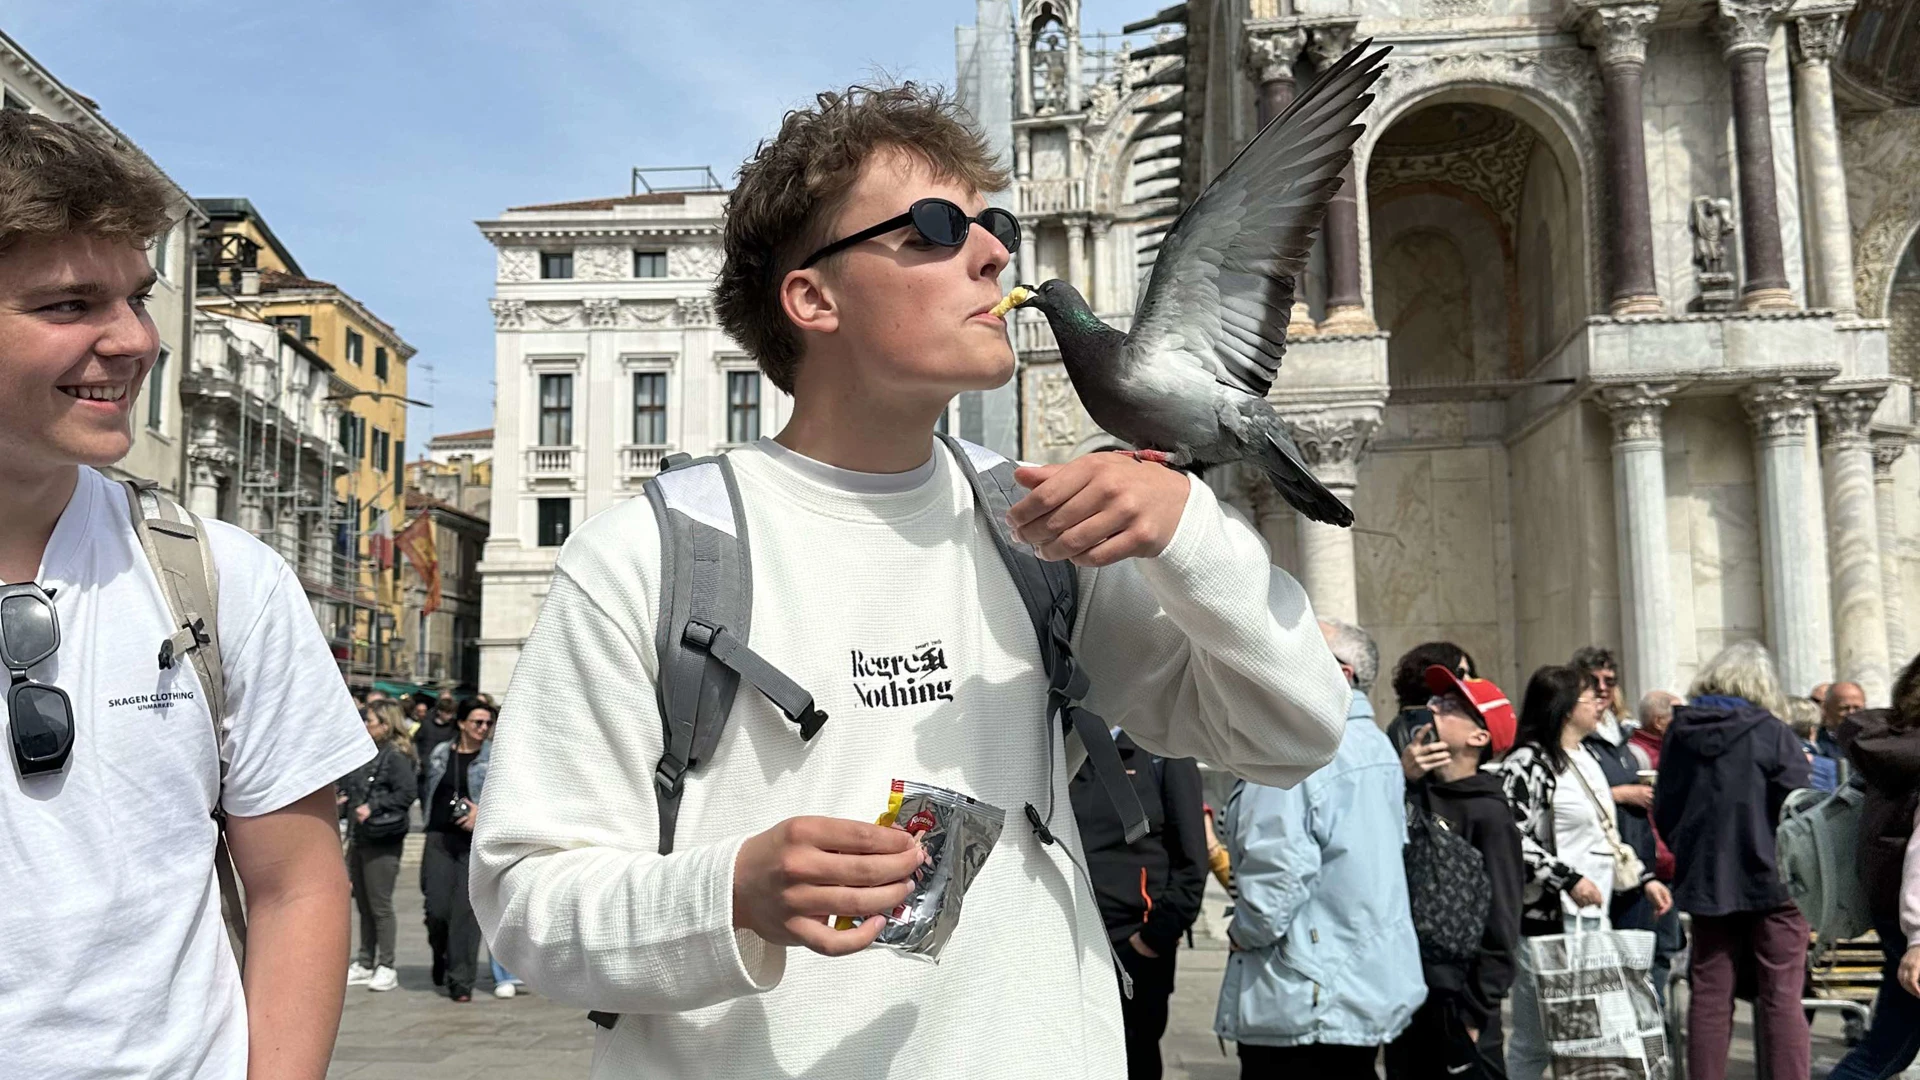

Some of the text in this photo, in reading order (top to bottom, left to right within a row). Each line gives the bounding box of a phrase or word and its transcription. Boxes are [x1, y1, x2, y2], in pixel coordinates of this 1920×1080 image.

[108, 691, 194, 707] SKAGEN CLOTHING
[853, 677, 954, 708] Nothing
[137, 702, 174, 710] UNMARKED
